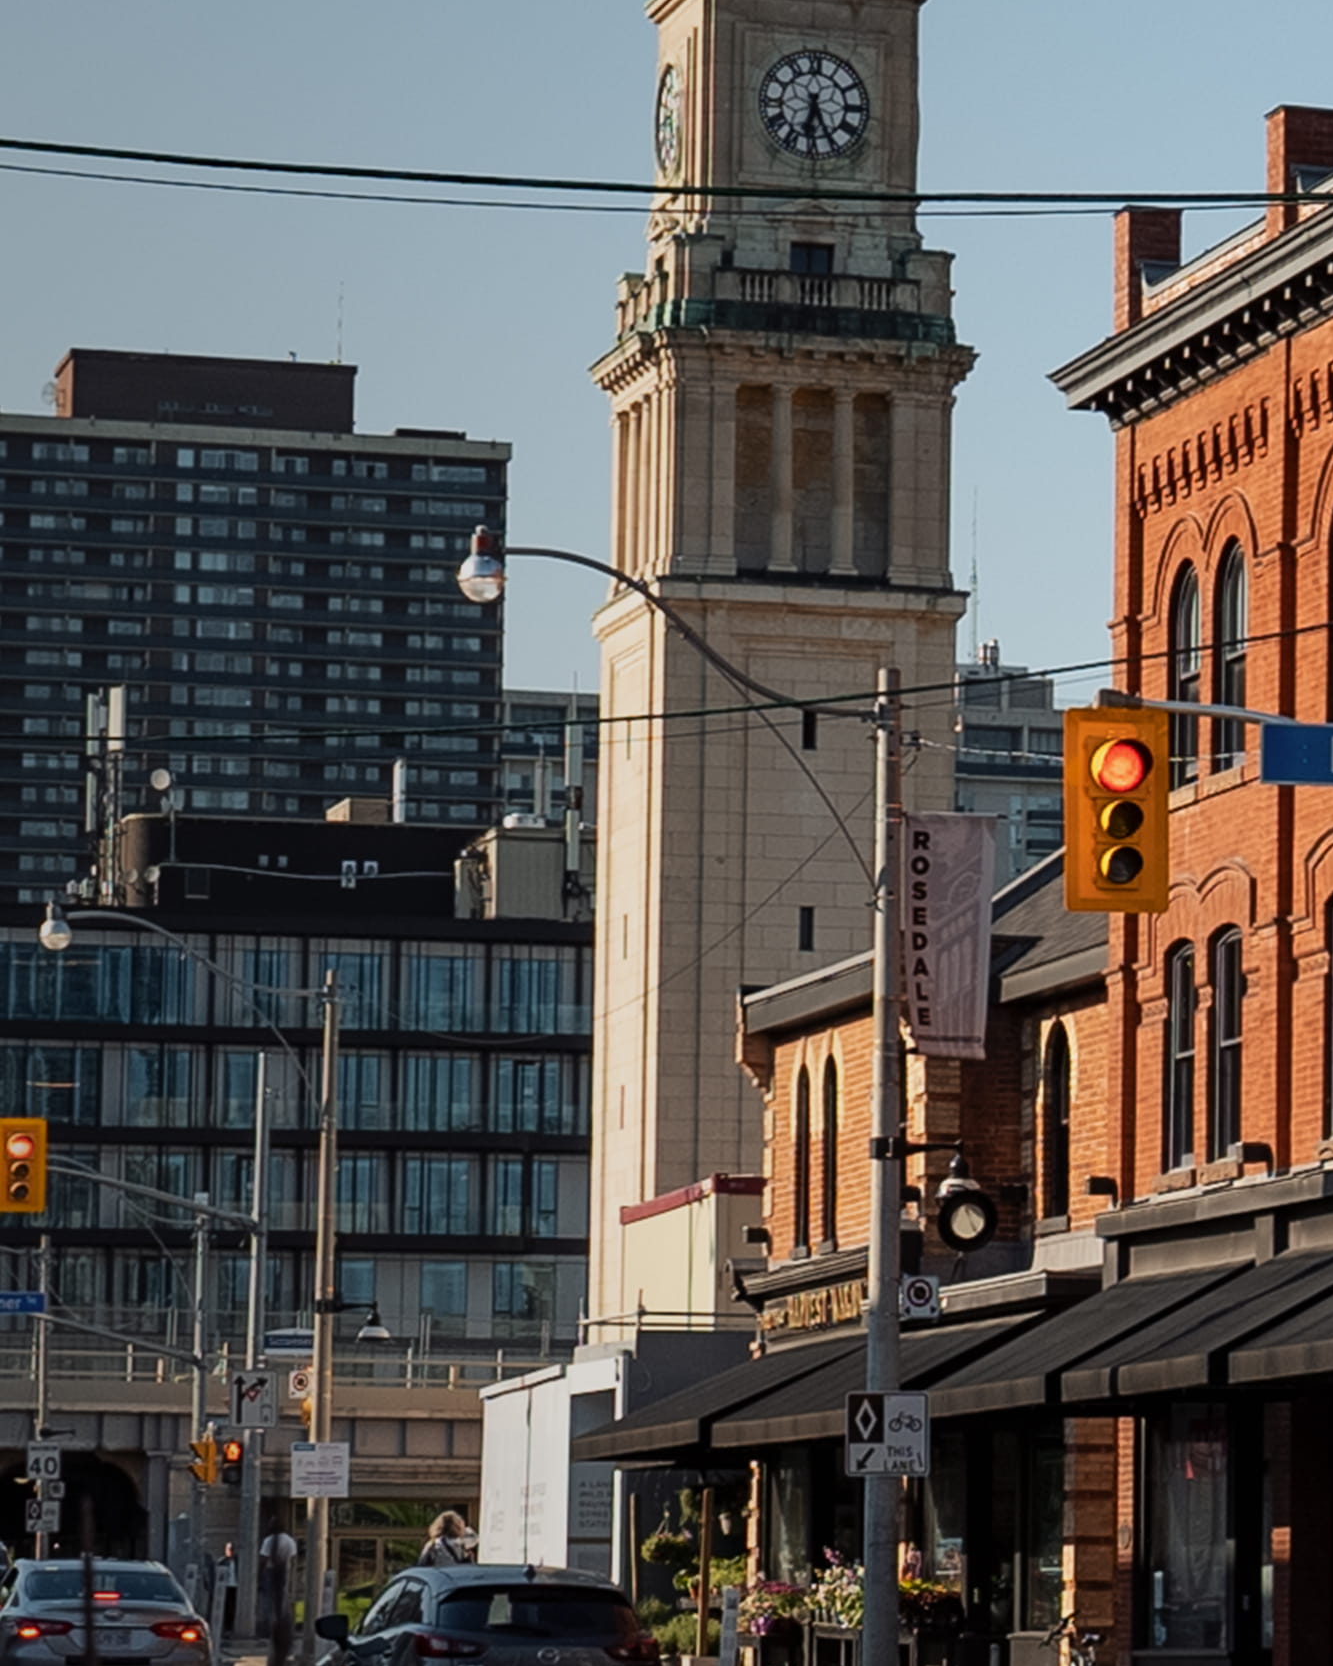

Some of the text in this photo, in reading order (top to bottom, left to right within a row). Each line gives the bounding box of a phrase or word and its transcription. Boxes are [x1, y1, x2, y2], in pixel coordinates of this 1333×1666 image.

[911, 830, 931, 1026] ROSEDALE
[887, 1445, 914, 1457] THIS
[30, 1456, 57, 1475] 40
